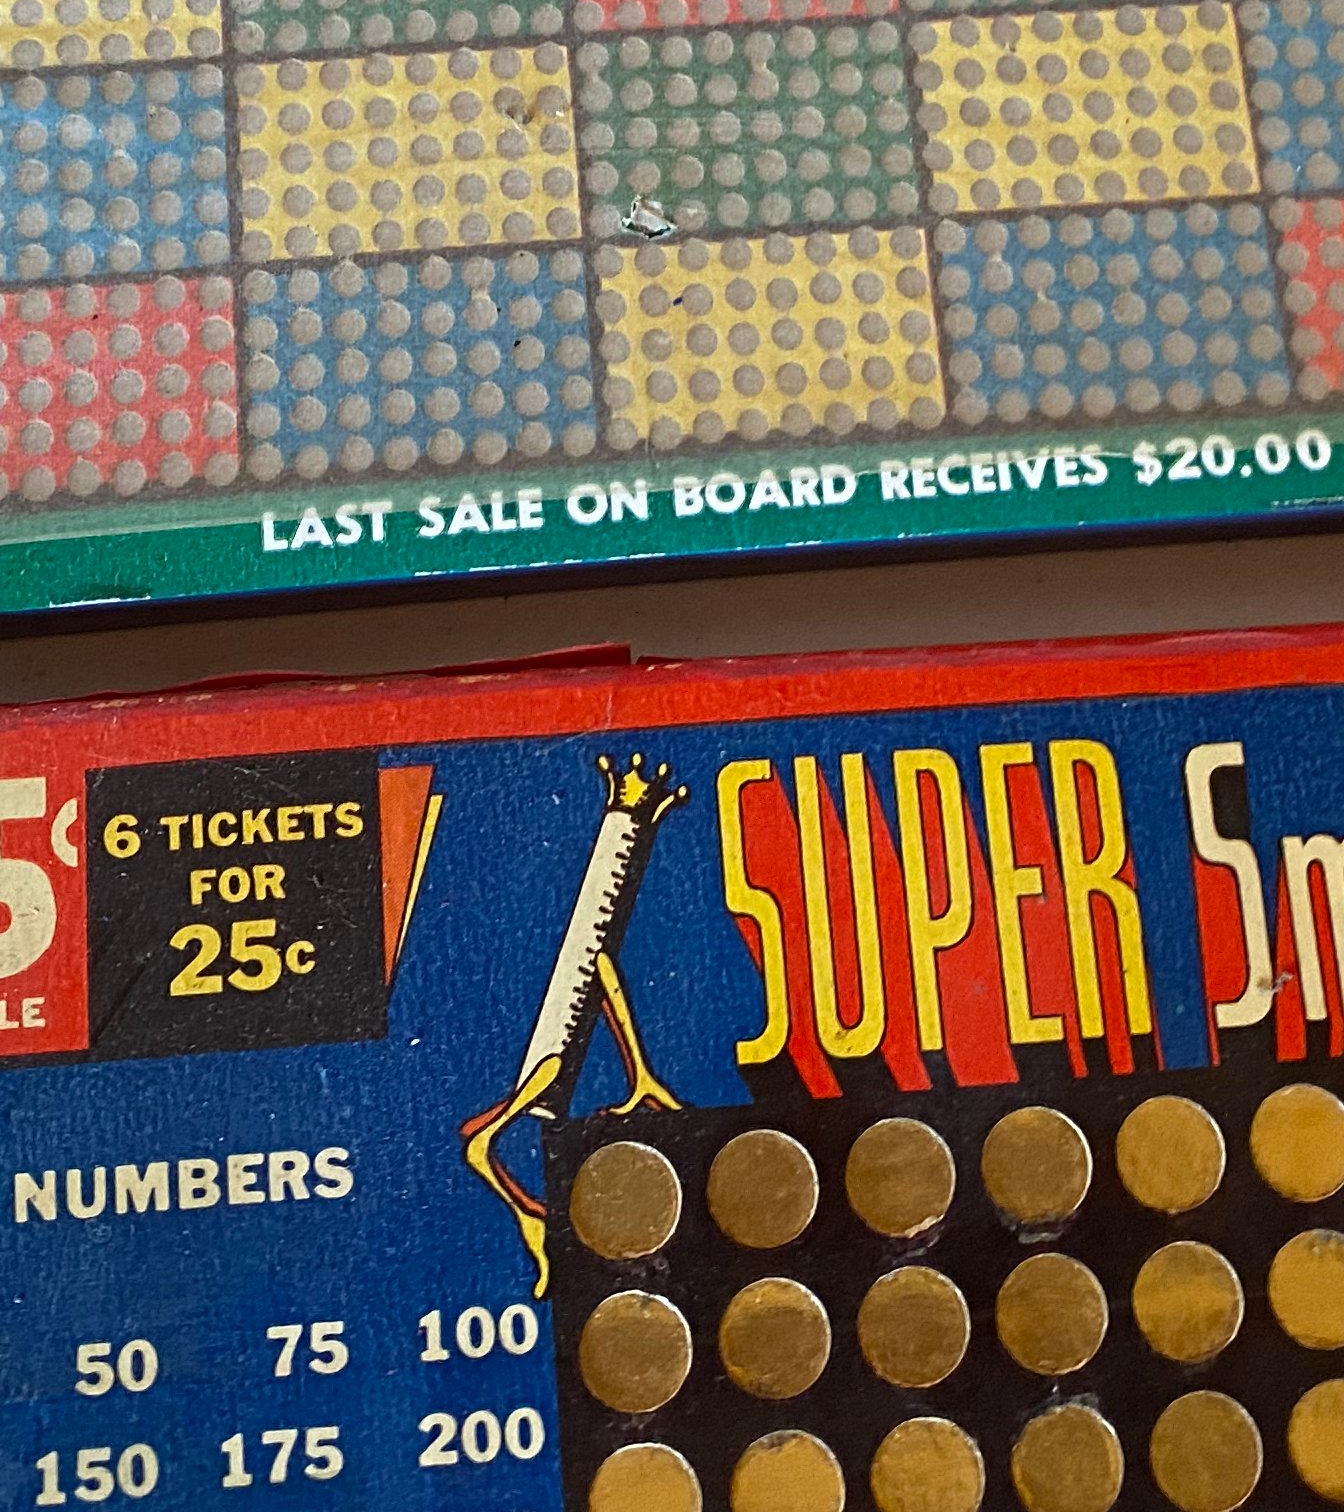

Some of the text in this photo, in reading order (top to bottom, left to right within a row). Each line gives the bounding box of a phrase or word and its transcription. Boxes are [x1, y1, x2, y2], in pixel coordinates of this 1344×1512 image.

[261, 429, 1333, 553] LAST SALE ON BOARD RECEIVES $20.00
[103, 802, 365, 858] 6 TICKETS
[191, 865, 286, 905] FOR
[717, 739, 1153, 1067] SUPER
[14, 1147, 355, 1223] NUMBERS
[75, 1339, 159, 1396] 50
[267, 1321, 349, 1378] 75
[419, 1304, 540, 1362] 100
[35, 1444, 160, 1506] 150
[221, 1427, 345, 1489] 175
[419, 1407, 546, 1468] 200
